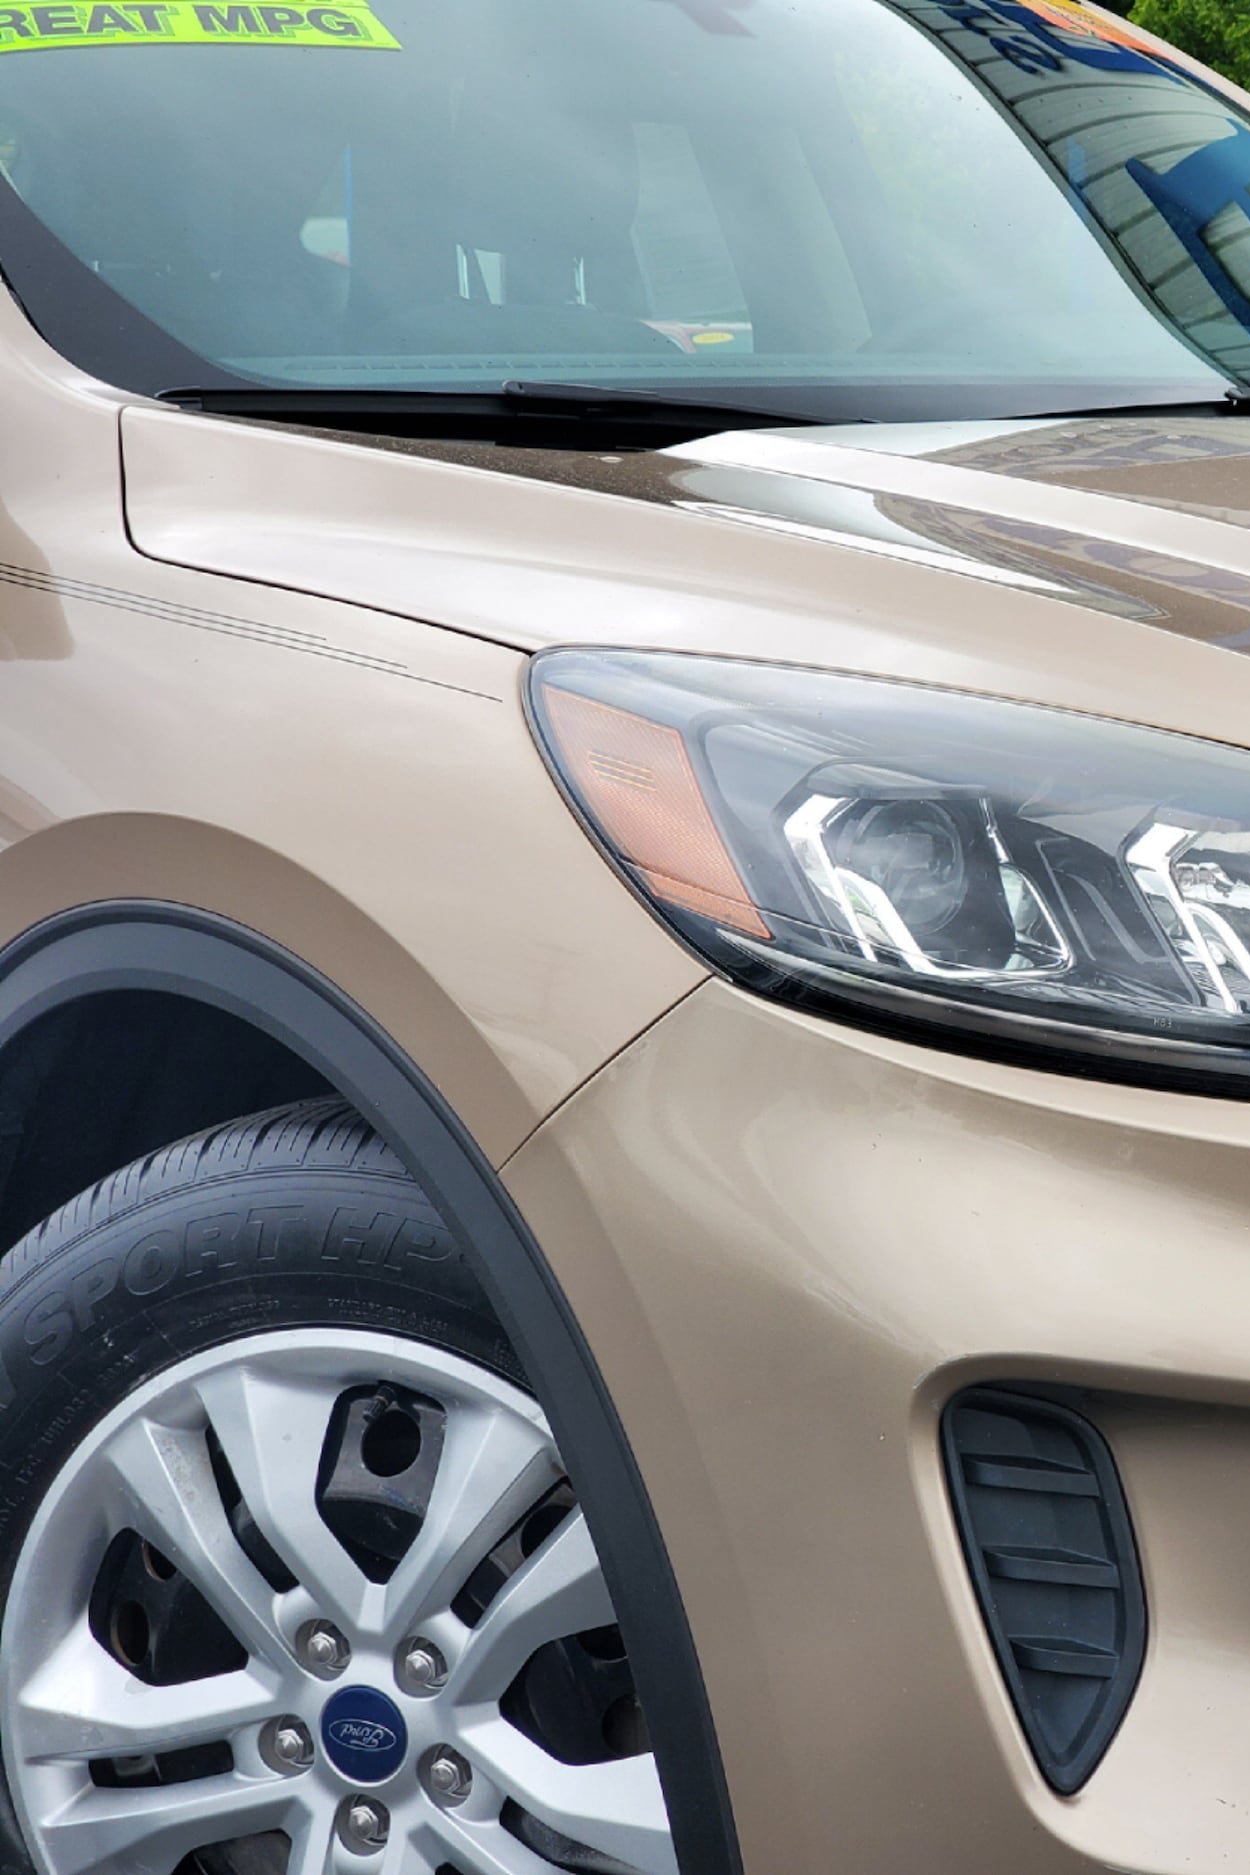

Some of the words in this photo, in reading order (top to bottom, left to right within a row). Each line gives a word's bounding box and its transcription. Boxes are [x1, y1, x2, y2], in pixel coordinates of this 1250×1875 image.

[193, 5, 366, 38] MPG
[24, 1204, 304, 1365] SPORT
[340, 1723, 385, 1748] Ford
